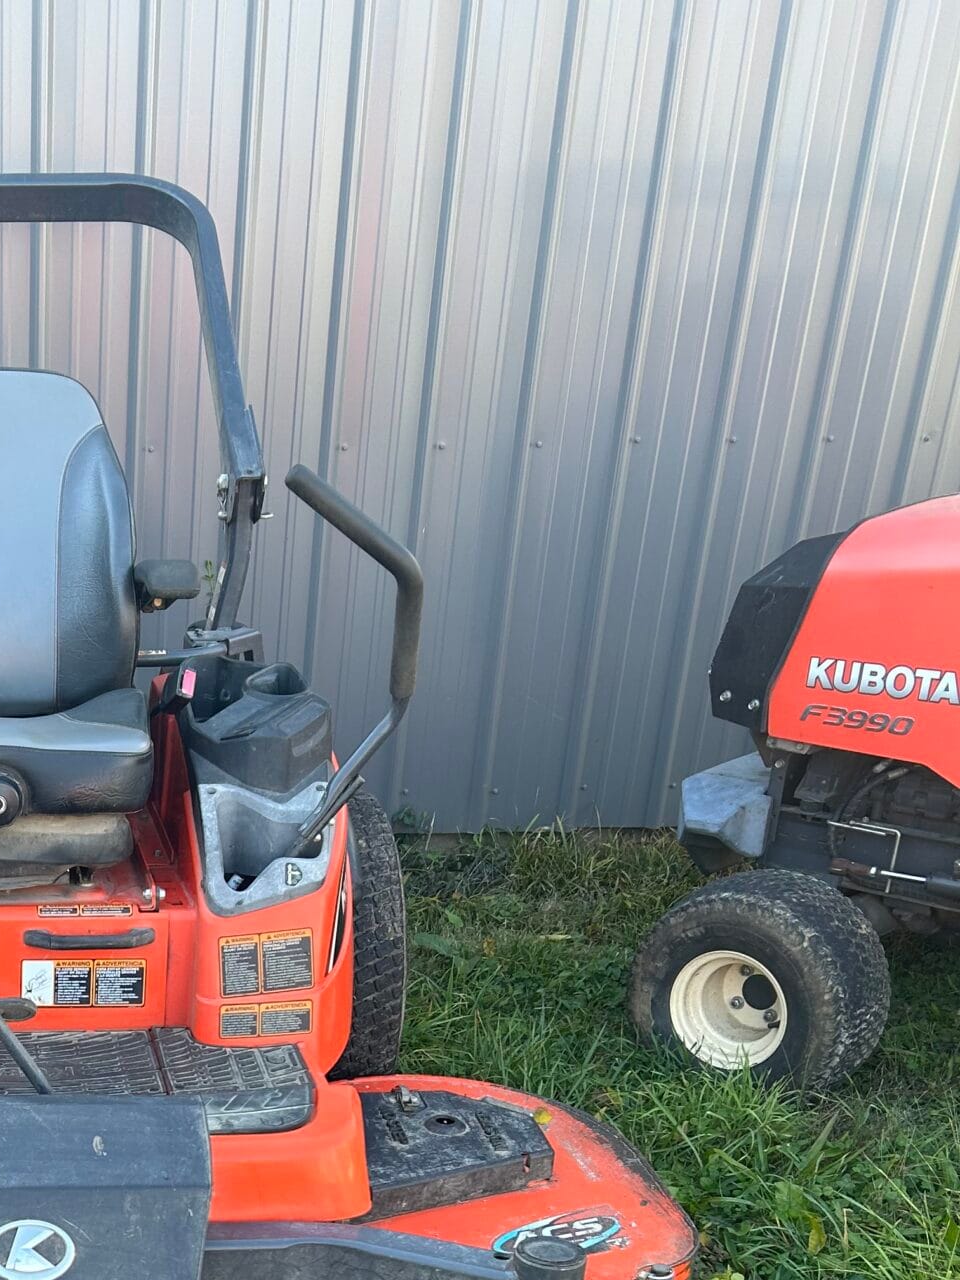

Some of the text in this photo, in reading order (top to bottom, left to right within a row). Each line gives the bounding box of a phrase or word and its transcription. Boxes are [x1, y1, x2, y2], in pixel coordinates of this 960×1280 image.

[805, 656, 960, 706] KUBOTA
[799, 703, 916, 736] F3990
[273, 931, 306, 939] ADVERTENCIA
[270, 1002, 307, 1010] ADVERTENCIA
